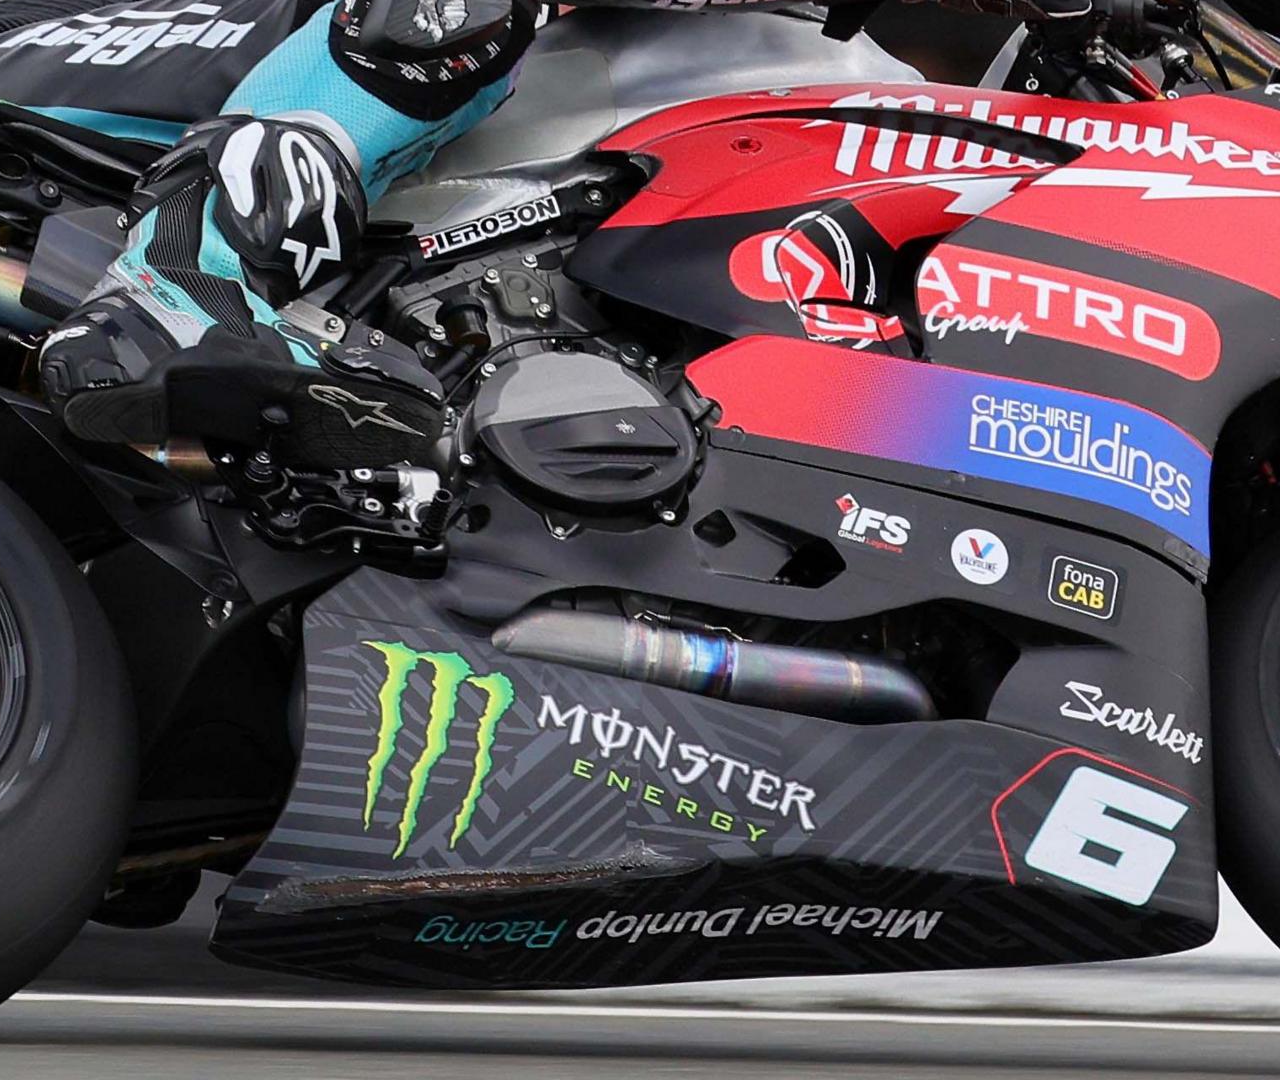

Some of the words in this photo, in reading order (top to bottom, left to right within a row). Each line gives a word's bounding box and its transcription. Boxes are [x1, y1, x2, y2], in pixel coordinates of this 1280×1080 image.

[419, 196, 560, 259] PIEROBON
[925, 301, 1029, 344] Group
[972, 395, 1082, 432] CHESHIRE
[970, 415, 1192, 512] mouldings
[837, 529, 866, 544] Global
[1058, 581, 1104, 609] CAB
[1064, 564, 1104, 591] fona
[1059, 680, 1204, 764] Scarlett
[573, 758, 767, 842] ENERGY
[1024, 765, 1190, 906] 6
[415, 914, 567, 949] Racing
[575, 907, 745, 945] Dunlop
[747, 902, 944, 941] Michael
